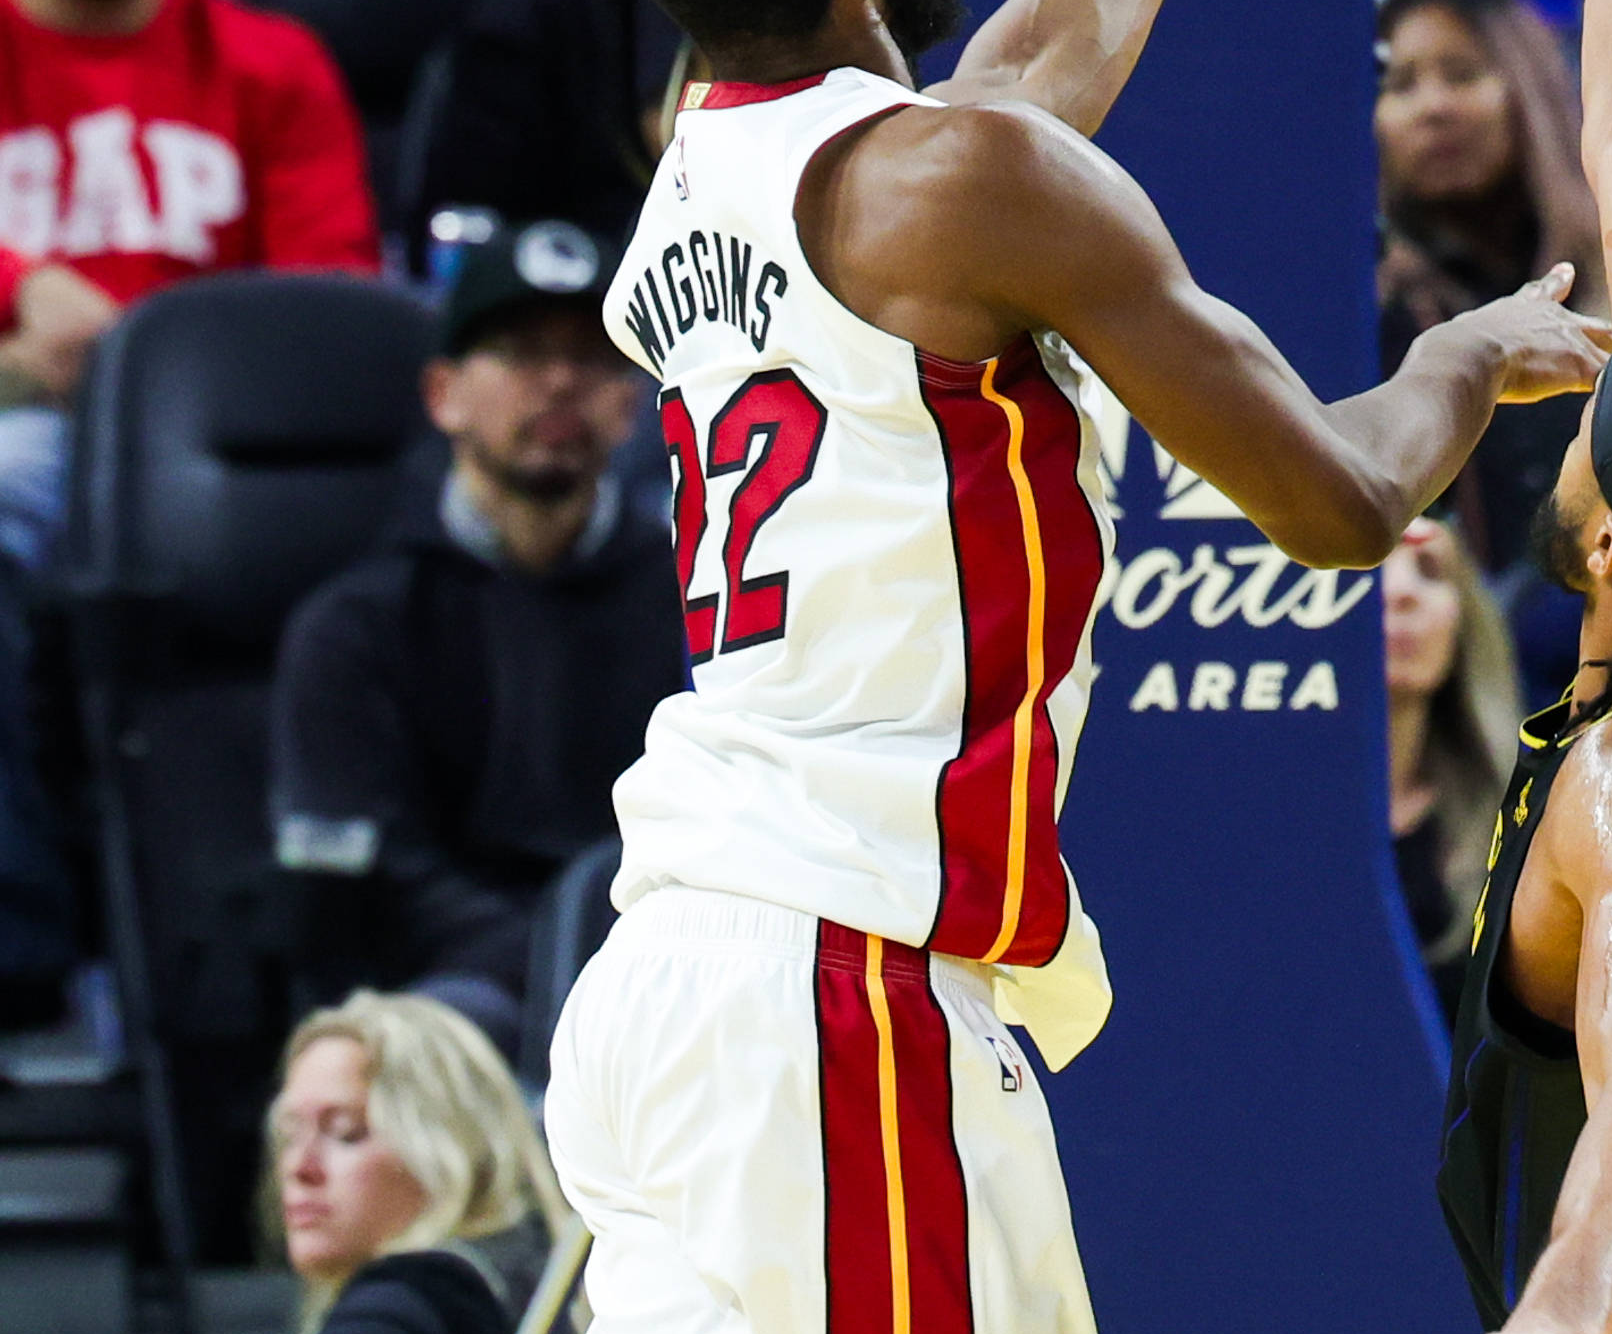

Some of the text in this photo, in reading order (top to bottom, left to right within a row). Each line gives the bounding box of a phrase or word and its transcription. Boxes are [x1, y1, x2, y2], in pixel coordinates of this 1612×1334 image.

[625, 229, 789, 366] WIGGINS
[1097, 543, 1374, 630] orts
[1128, 661, 1340, 713] AREA
